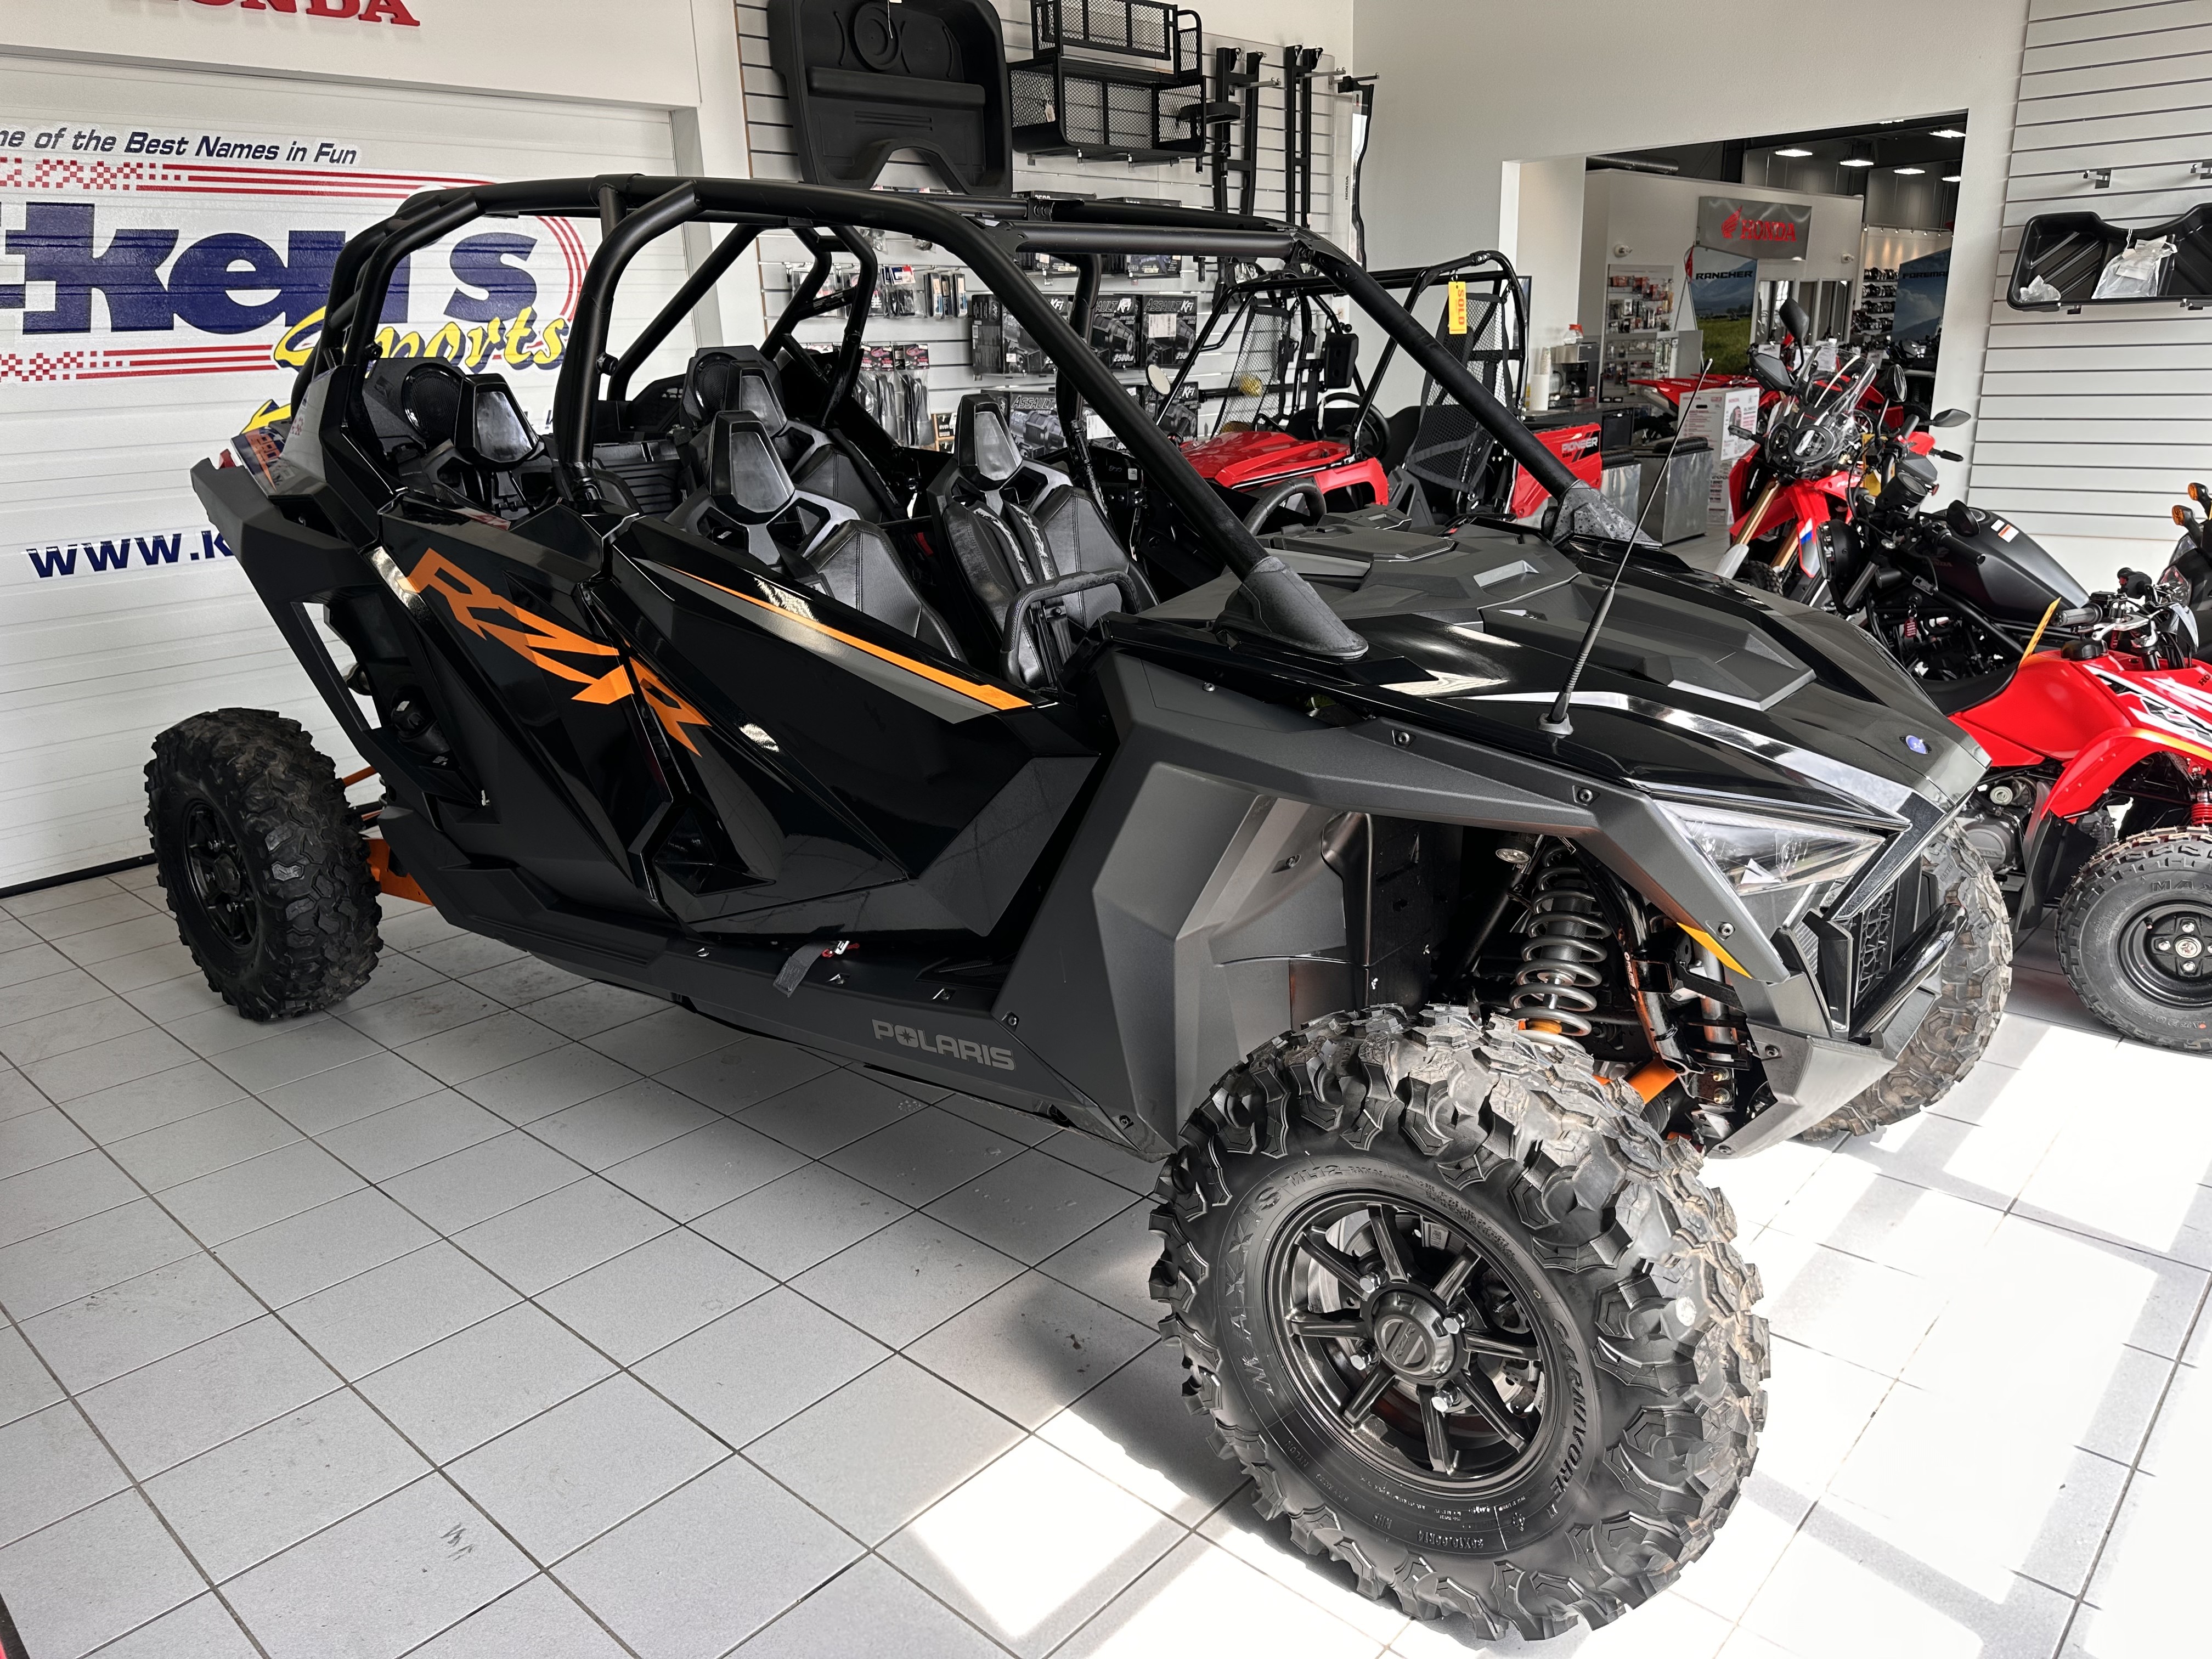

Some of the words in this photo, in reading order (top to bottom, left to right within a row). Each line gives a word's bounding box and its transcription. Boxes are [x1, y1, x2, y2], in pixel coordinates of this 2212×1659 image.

[0, 130, 26, 148] ne
[34, 127, 67, 149] of
[72, 129, 117, 152] the
[124, 131, 189, 156] Best
[195, 136, 280, 160] Names
[286, 141, 307, 162] in
[313, 143, 357, 164] Fun
[1740, 219, 1797, 242] HONDA
[5, 201, 538, 335] kens
[1695, 270, 1753, 280] RANCHER
[1095, 300, 1119, 313] AULT
[1143, 298, 1182, 312] ASSAULT
[1011, 395, 1056, 409] ASSAULT
[1561, 436, 1598, 452] PIONEER
[26, 530, 235, 578] www.k
[2197, 673, 2212, 686] HO
[2152, 879, 2212, 893] MAX
[871, 1019, 1016, 1071] POLARIS
[1224, 1186, 1282, 1397] MAXXIS
[1284, 1165, 1345, 1188] ML12
[1391, 1322, 1416, 1365] RZR
[1550, 1319, 1587, 1503] CARNIVORE
[1285, 1440, 1309, 1468] NYLON
[1372, 1513, 1393, 1530] NHS
